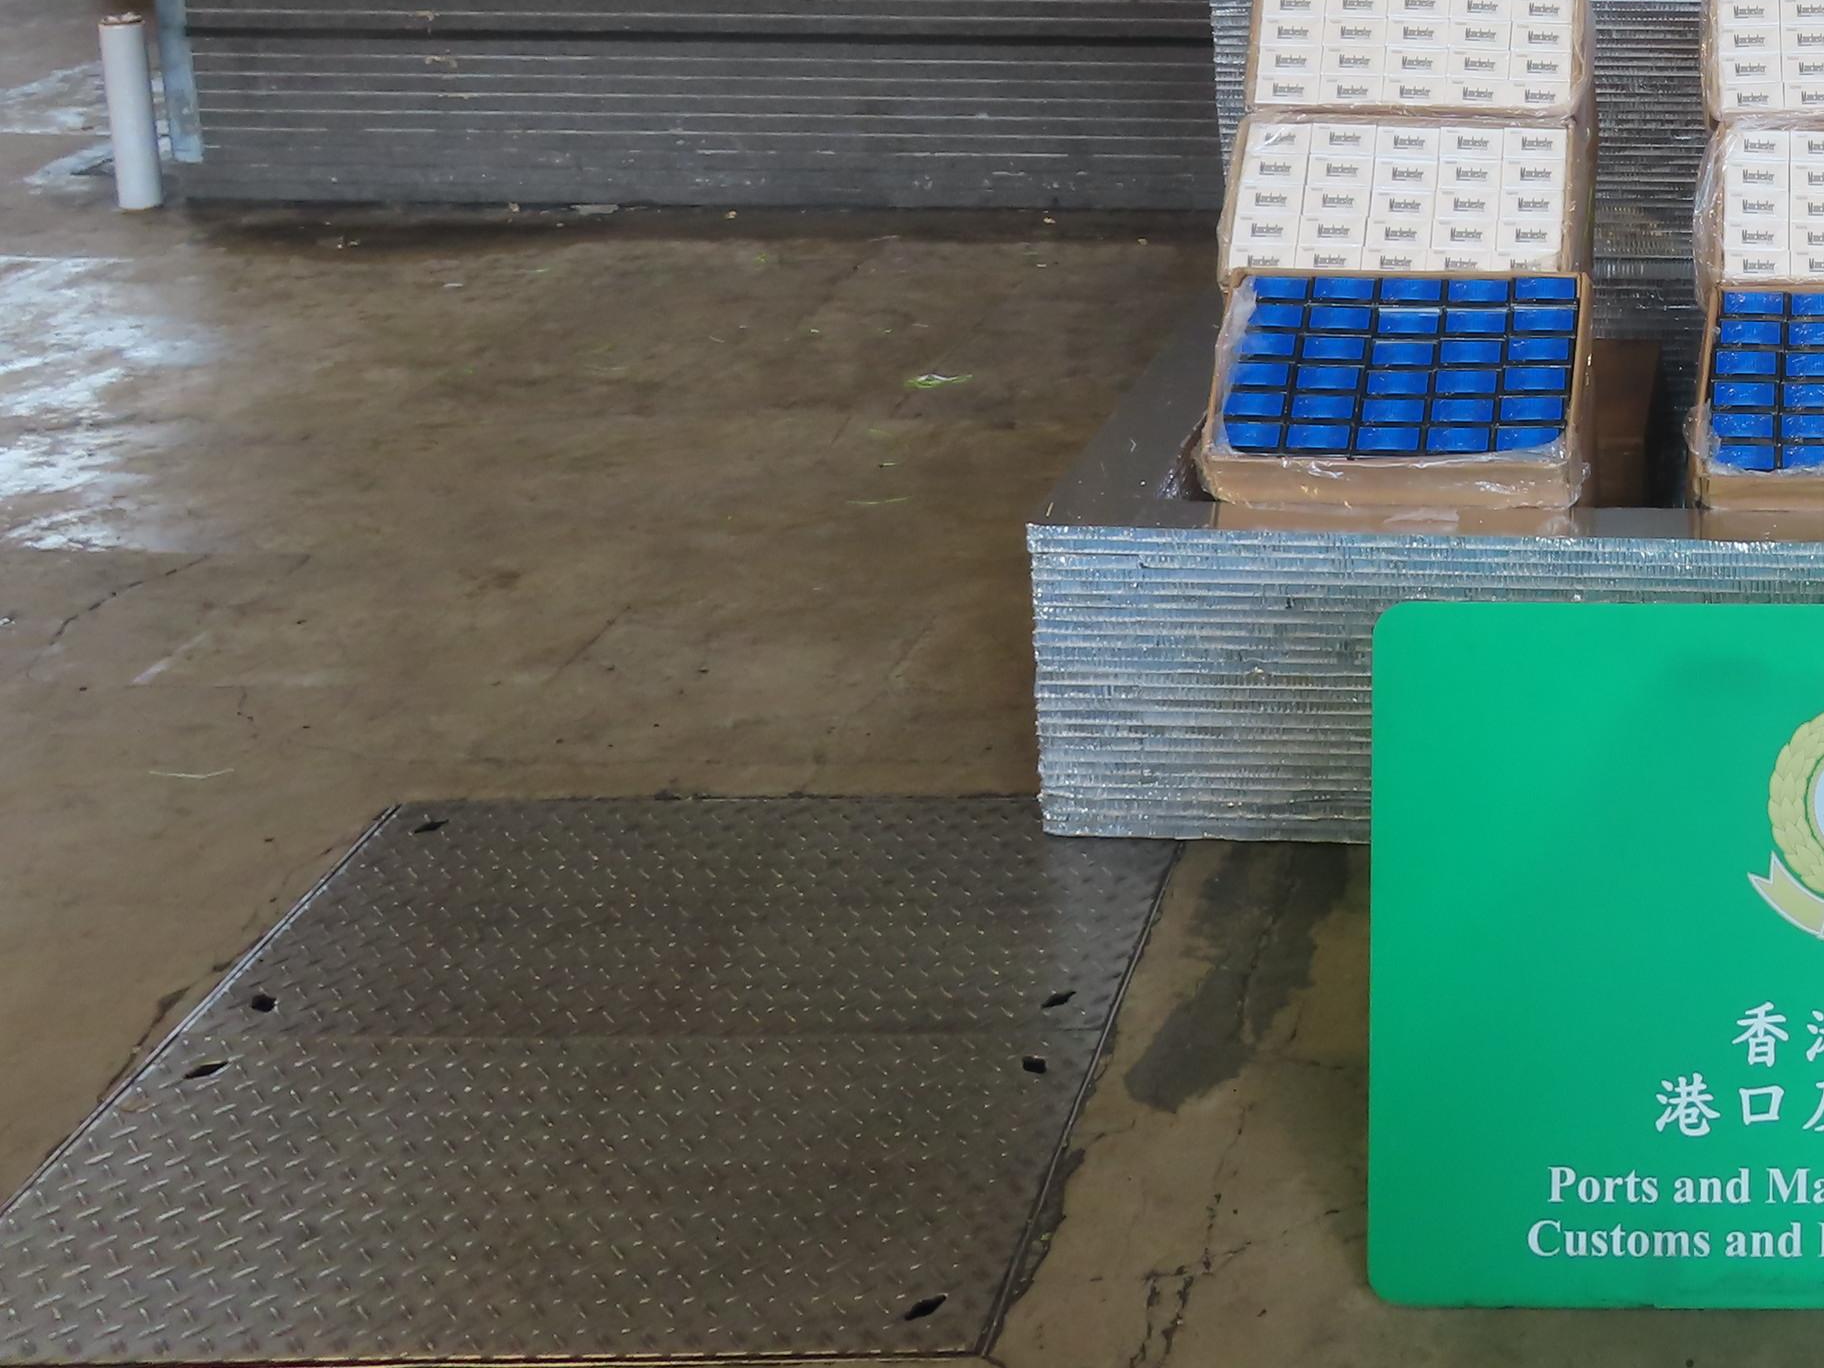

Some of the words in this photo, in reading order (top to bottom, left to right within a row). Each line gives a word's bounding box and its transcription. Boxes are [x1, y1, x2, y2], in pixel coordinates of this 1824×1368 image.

[1547, 1166, 1659, 1206] Ports
[1673, 1167, 1751, 1206] and
[1527, 1219, 1711, 1260] Customs
[1725, 1220, 1803, 1260] and
